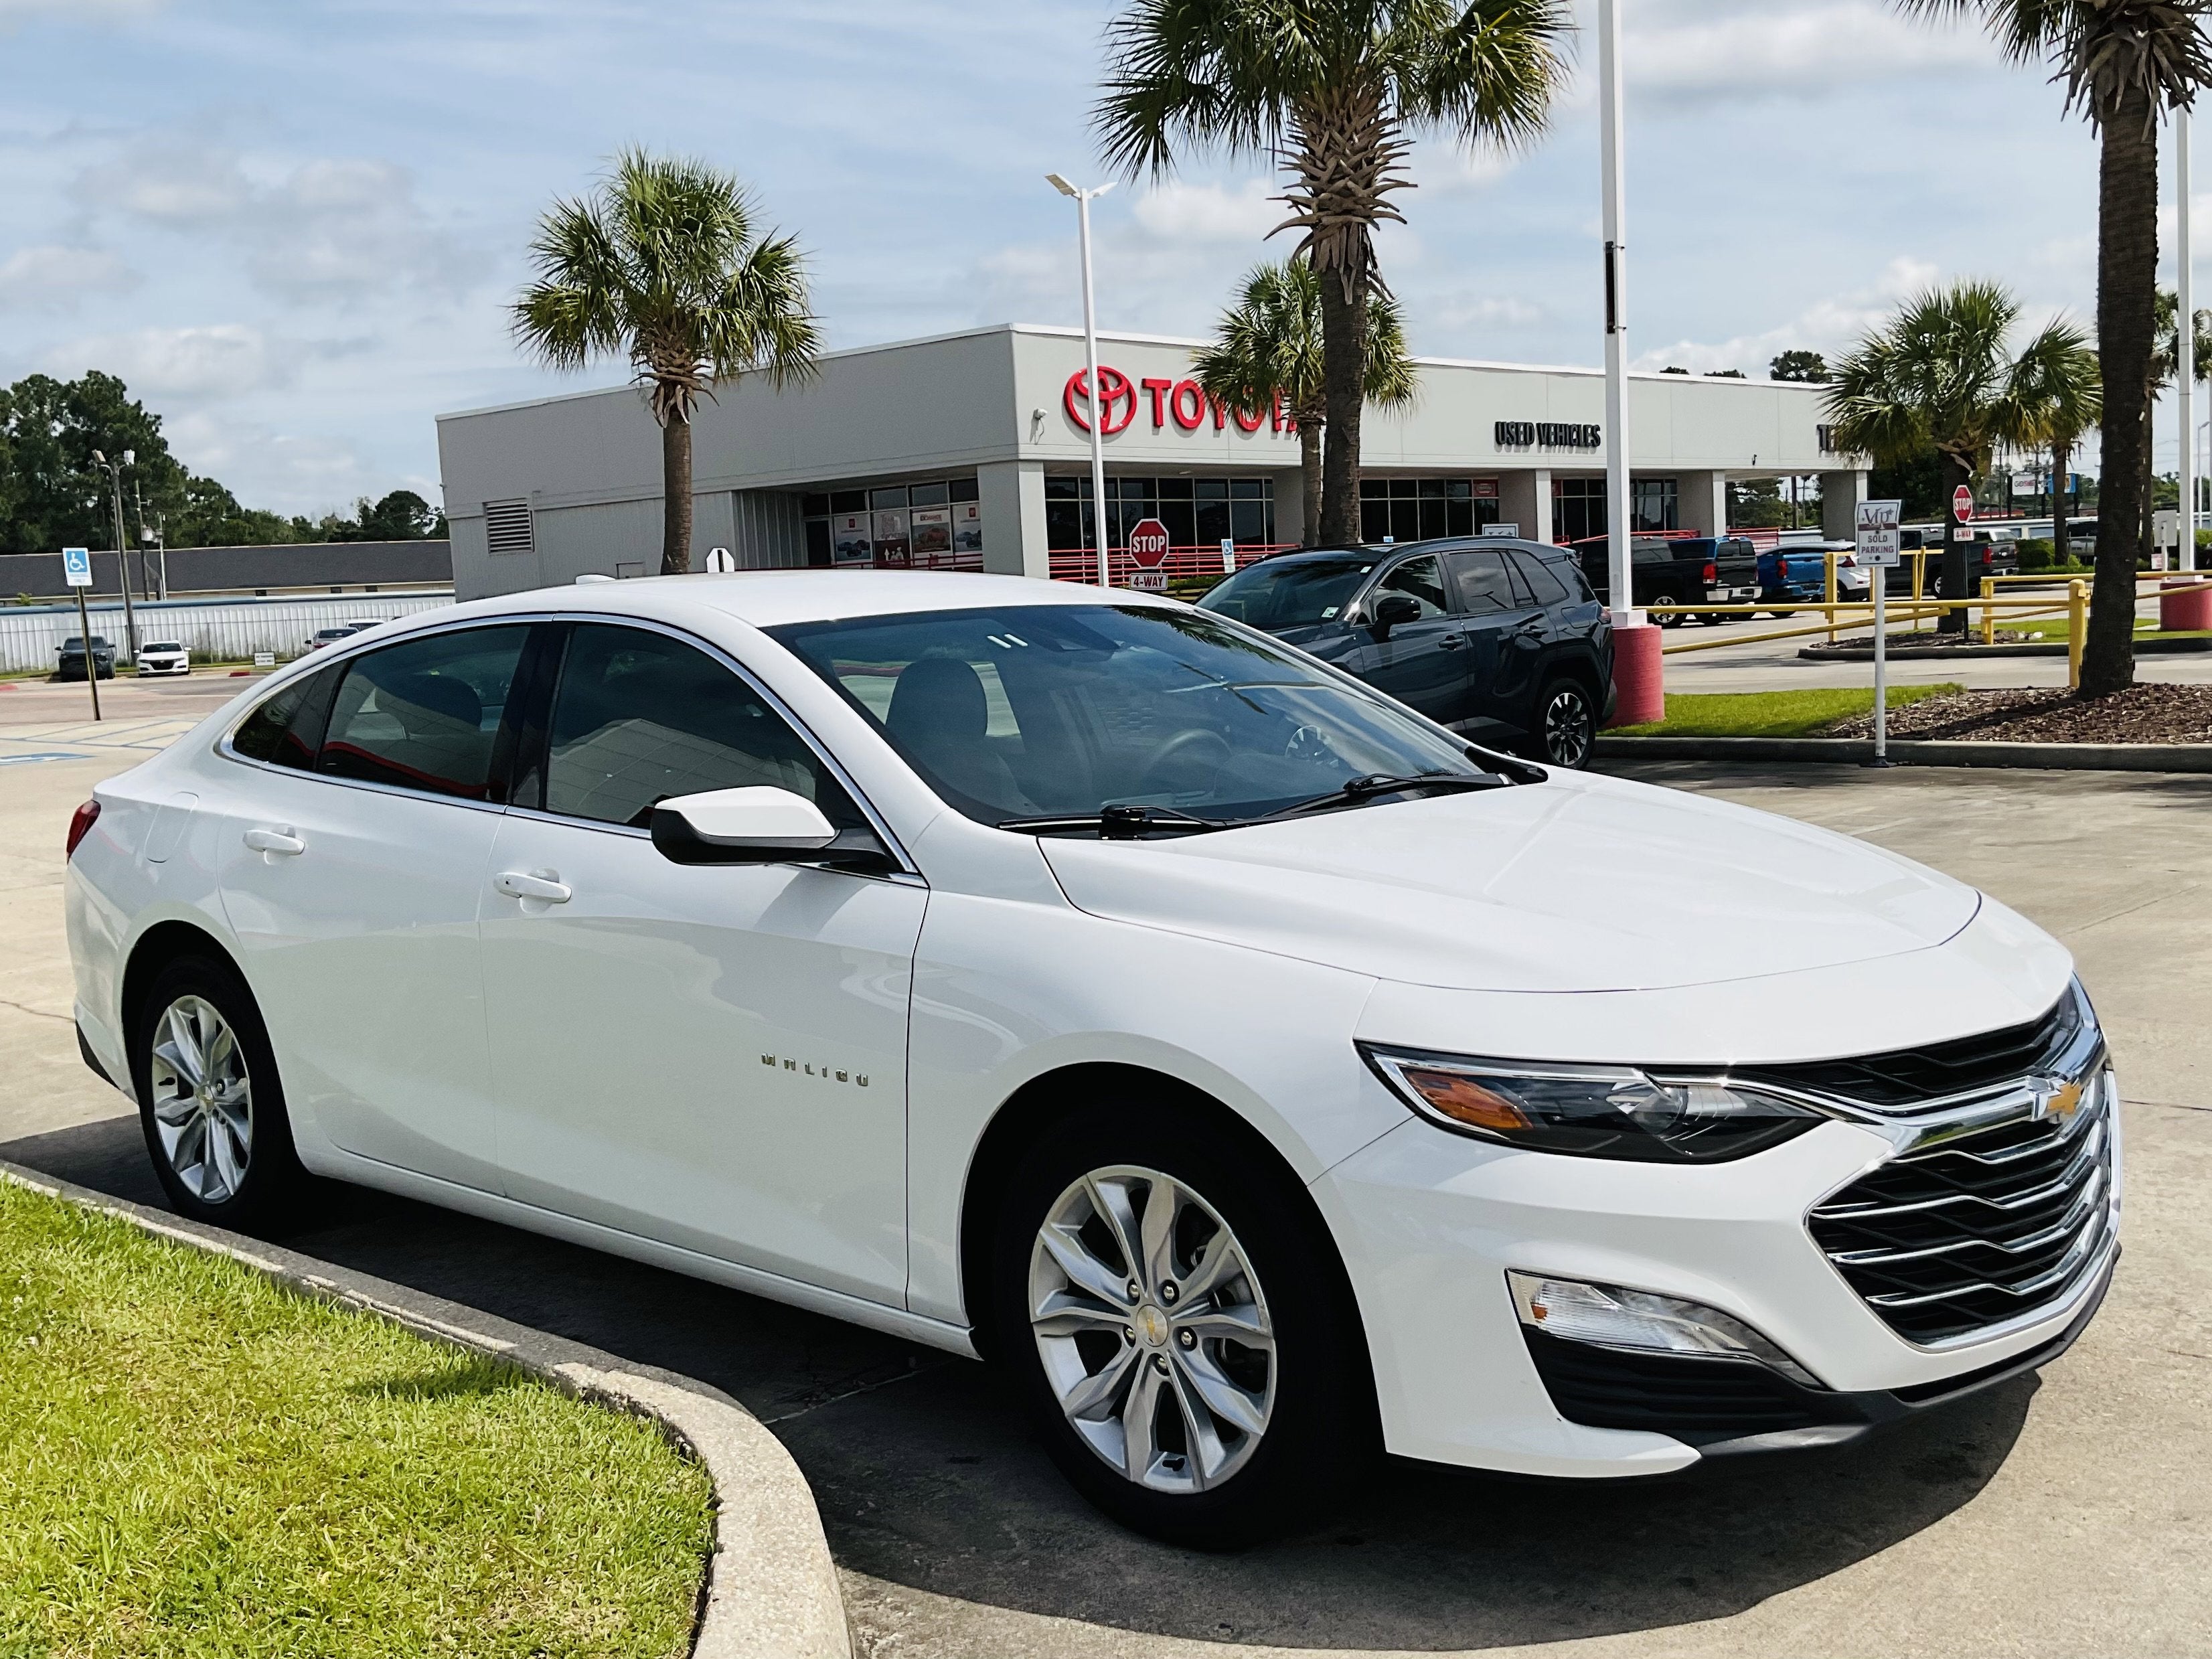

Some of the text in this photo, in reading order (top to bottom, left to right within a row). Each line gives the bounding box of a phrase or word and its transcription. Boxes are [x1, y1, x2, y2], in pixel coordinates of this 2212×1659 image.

[1141, 378, 1298, 432] TOYOT
[1495, 421, 1601, 447] USED VEHICLES
[1955, 497, 1971, 511] STOP
[1132, 535, 1166, 553] STOP
[1867, 535, 1888, 543] SOLD
[1861, 546, 1894, 554] PARKING
[1133, 576, 1164, 587] 4-WAY
[761, 1052, 869, 1087] MALIBU
